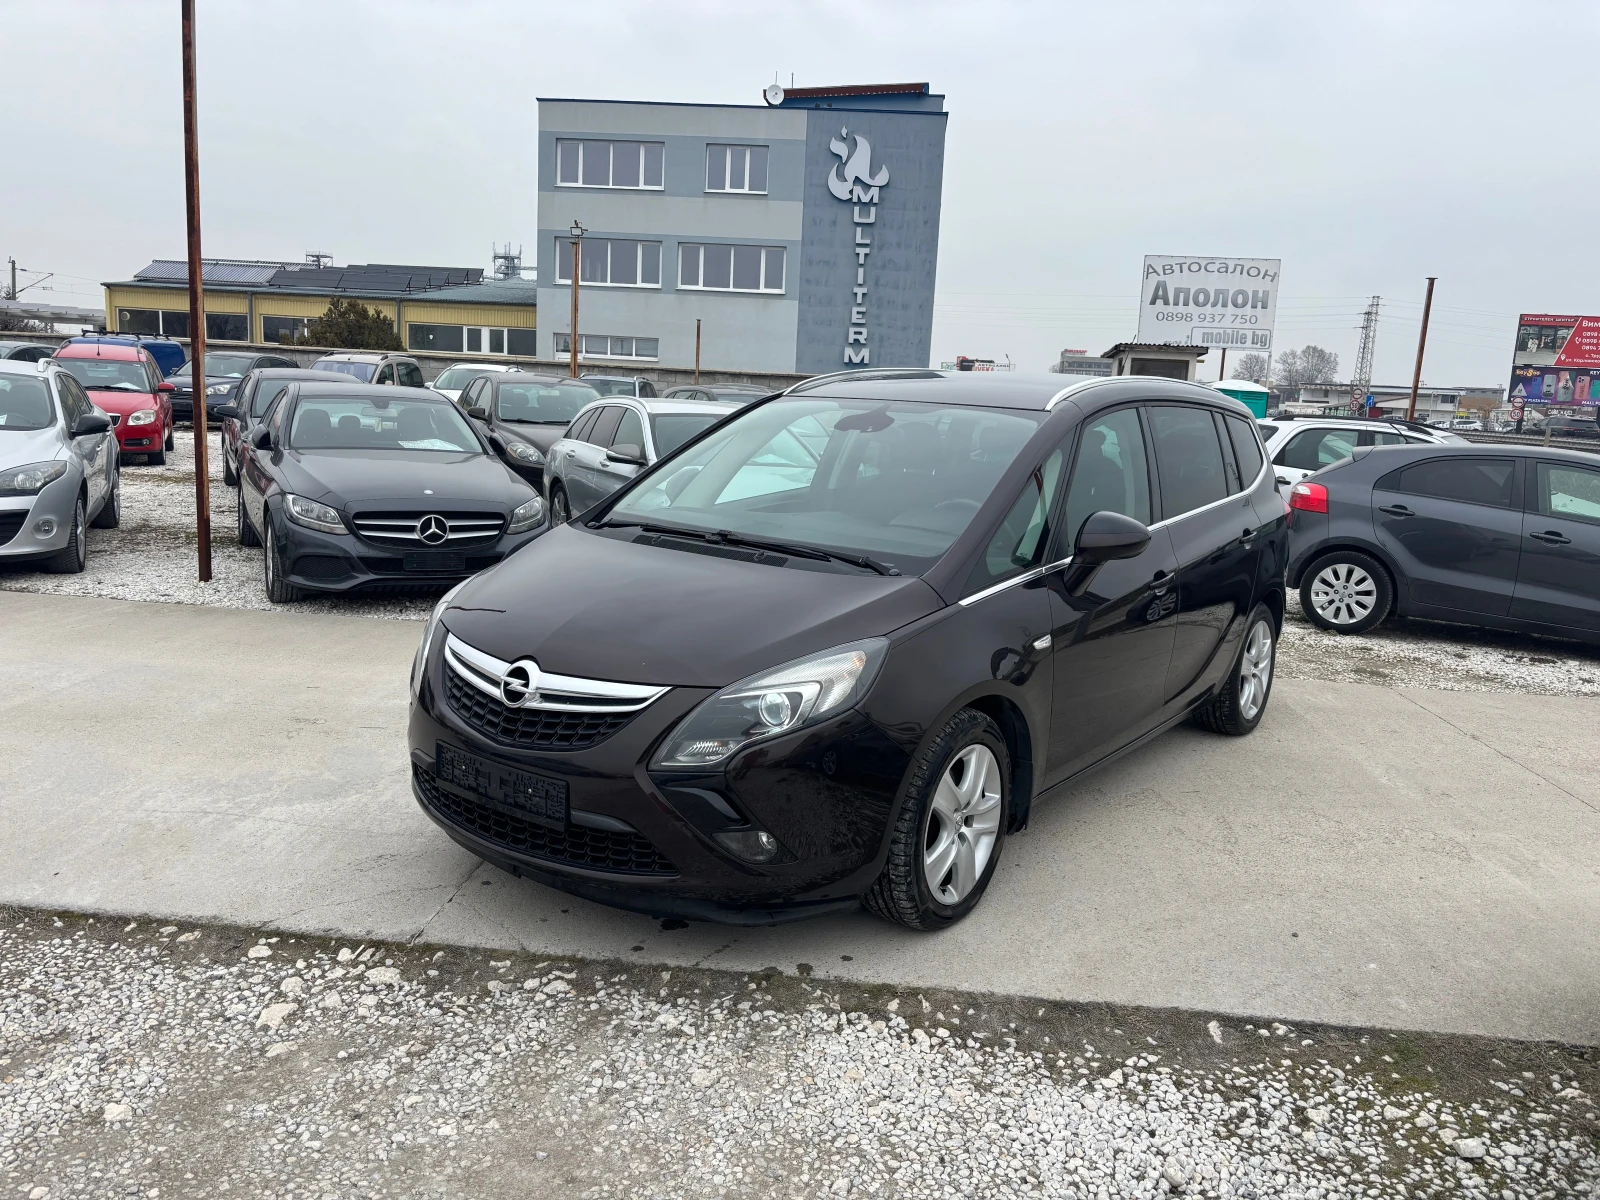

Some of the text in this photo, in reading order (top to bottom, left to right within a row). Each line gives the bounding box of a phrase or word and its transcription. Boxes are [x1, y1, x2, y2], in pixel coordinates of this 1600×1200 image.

[843, 185, 880, 365] MULTITERM
[1145, 261, 1278, 283] Автосалон
[1149, 280, 1270, 310] Аполон
[1155, 311, 1258, 325] 0898 937 750
[1201, 330, 1247, 345] mobile
